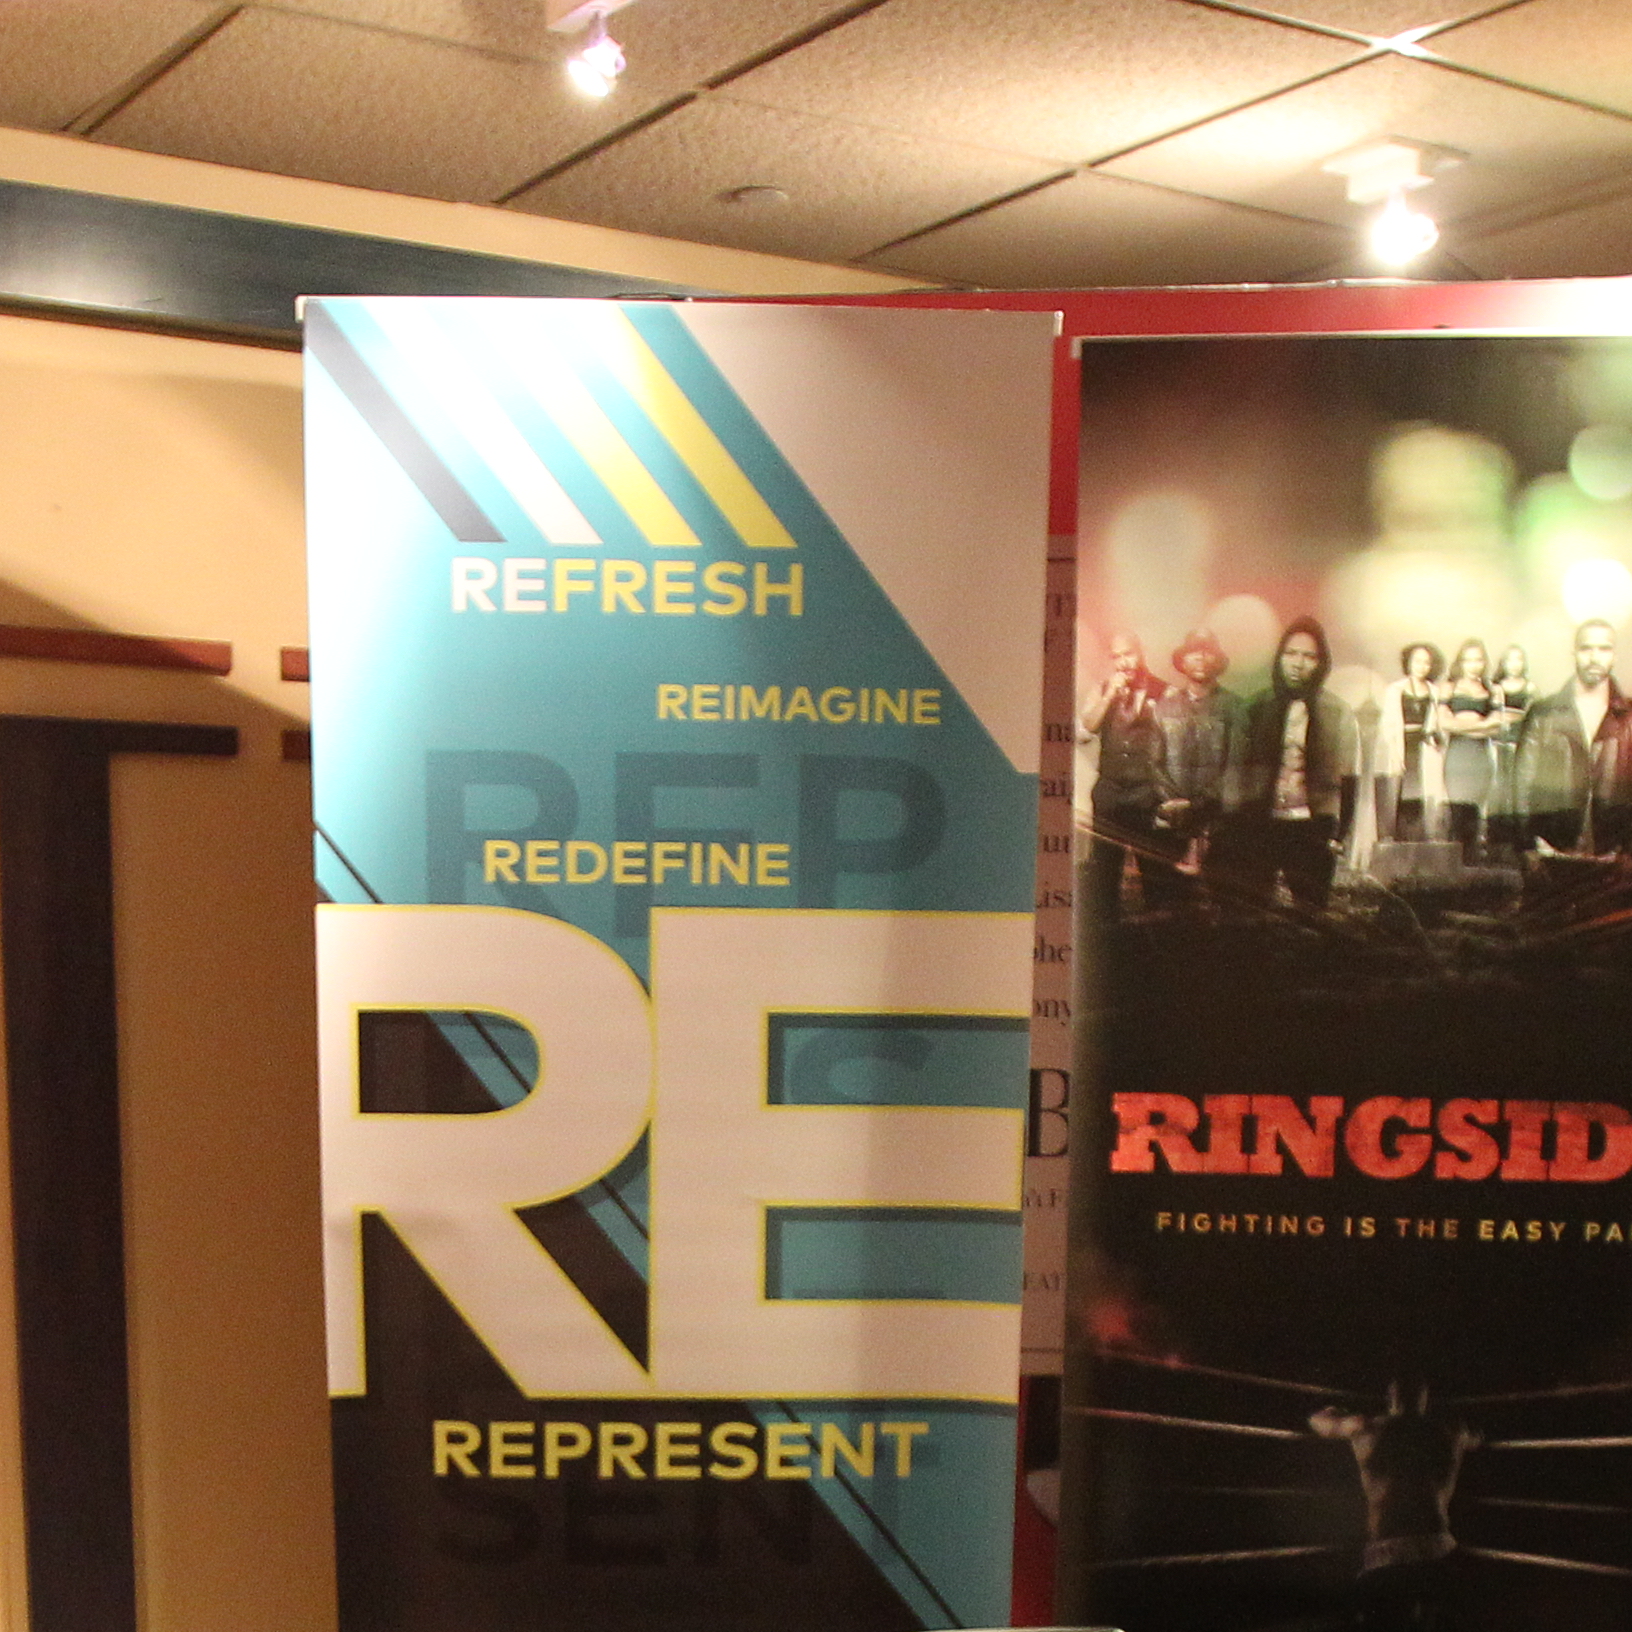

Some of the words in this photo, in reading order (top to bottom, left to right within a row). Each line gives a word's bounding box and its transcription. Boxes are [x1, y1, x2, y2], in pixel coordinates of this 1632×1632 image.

[450, 556, 804, 616] REFRESH
[655, 684, 942, 725] REIMAGINE
[483, 839, 791, 887] REDEFINE
[316, 902, 1030, 1402] RE
[1156, 1212, 1325, 1235] FIGHTING
[1345, 1215, 1376, 1236] IS
[1397, 1217, 1459, 1239] THE
[1479, 1218, 1566, 1243] EASY
[432, 1419, 929, 1480] REPRESENT
